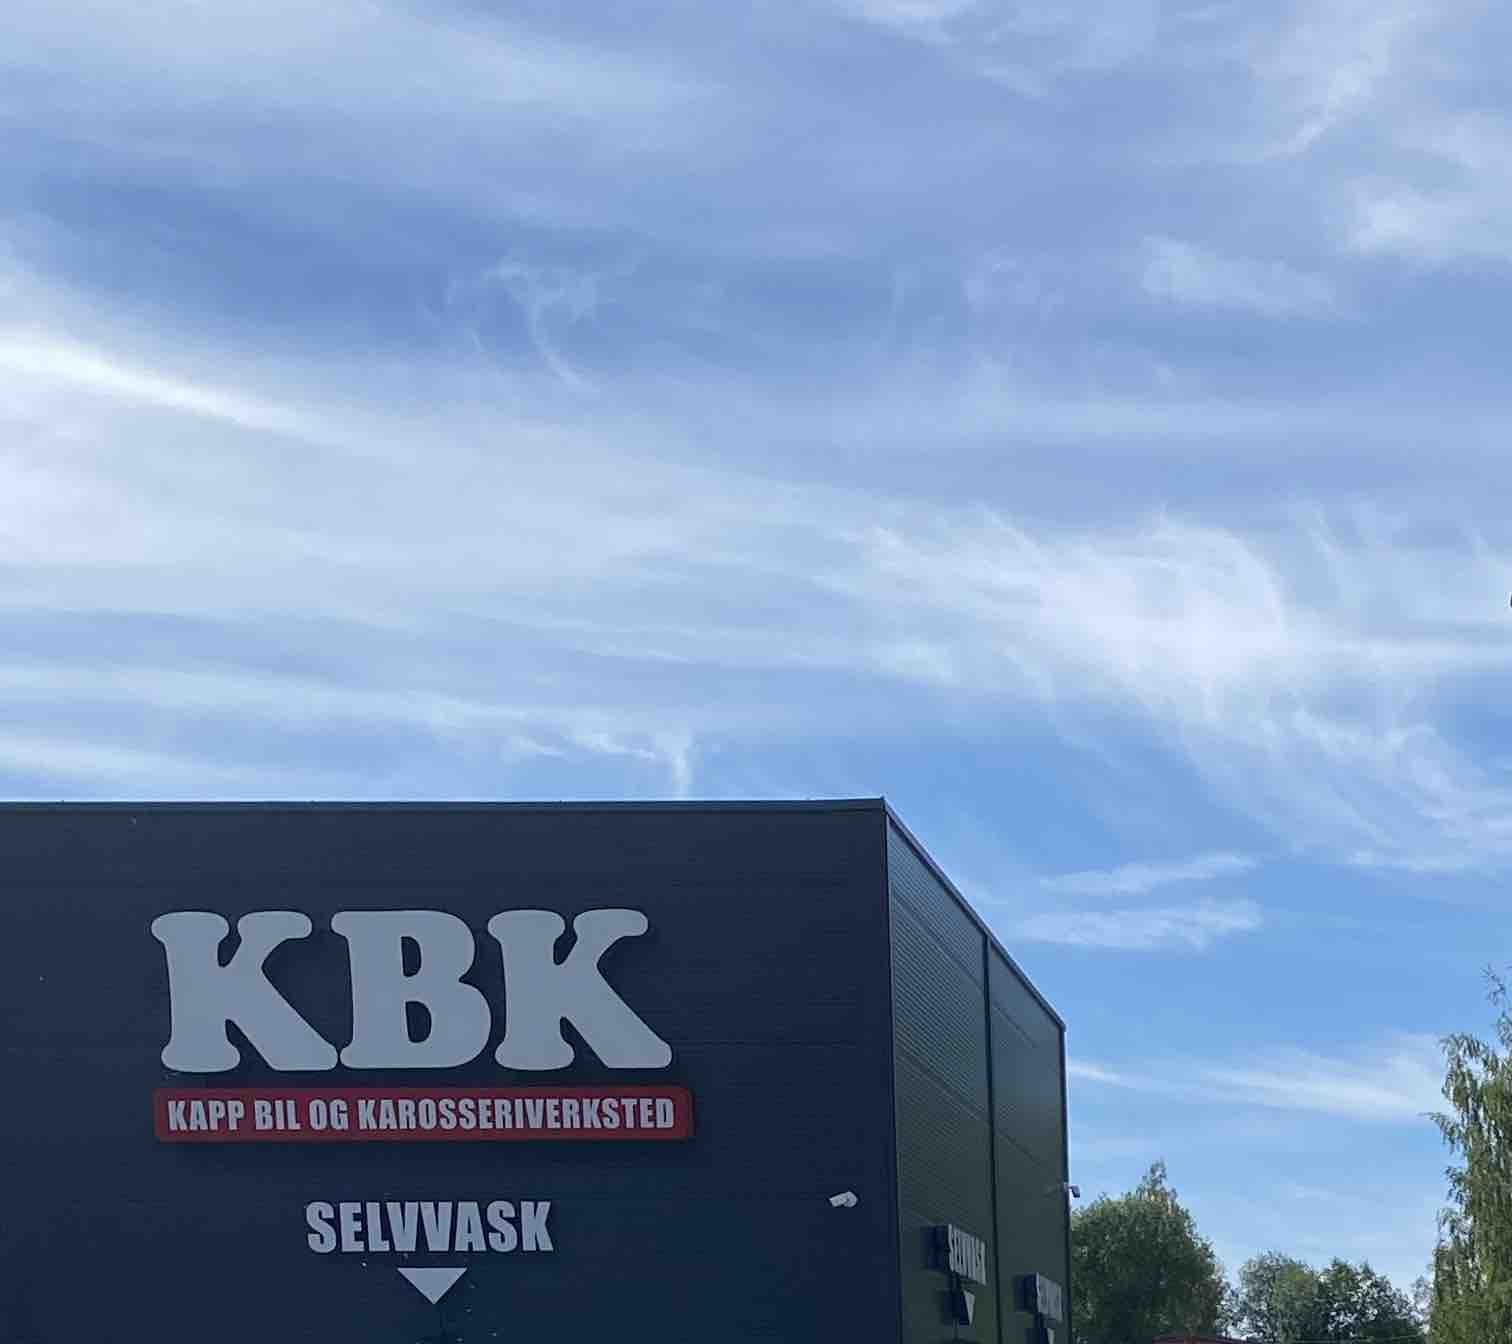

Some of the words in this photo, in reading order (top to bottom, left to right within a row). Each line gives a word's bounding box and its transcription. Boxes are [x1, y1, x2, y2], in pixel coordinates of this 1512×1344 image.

[151, 908, 672, 1072] KBK
[167, 1100, 246, 1132] KAPP
[255, 1100, 301, 1131] BIL
[309, 1099, 349, 1131] OG
[357, 1098, 675, 1130] KAROSSERIVERKSTED
[306, 1202, 554, 1253] SELVVASK
